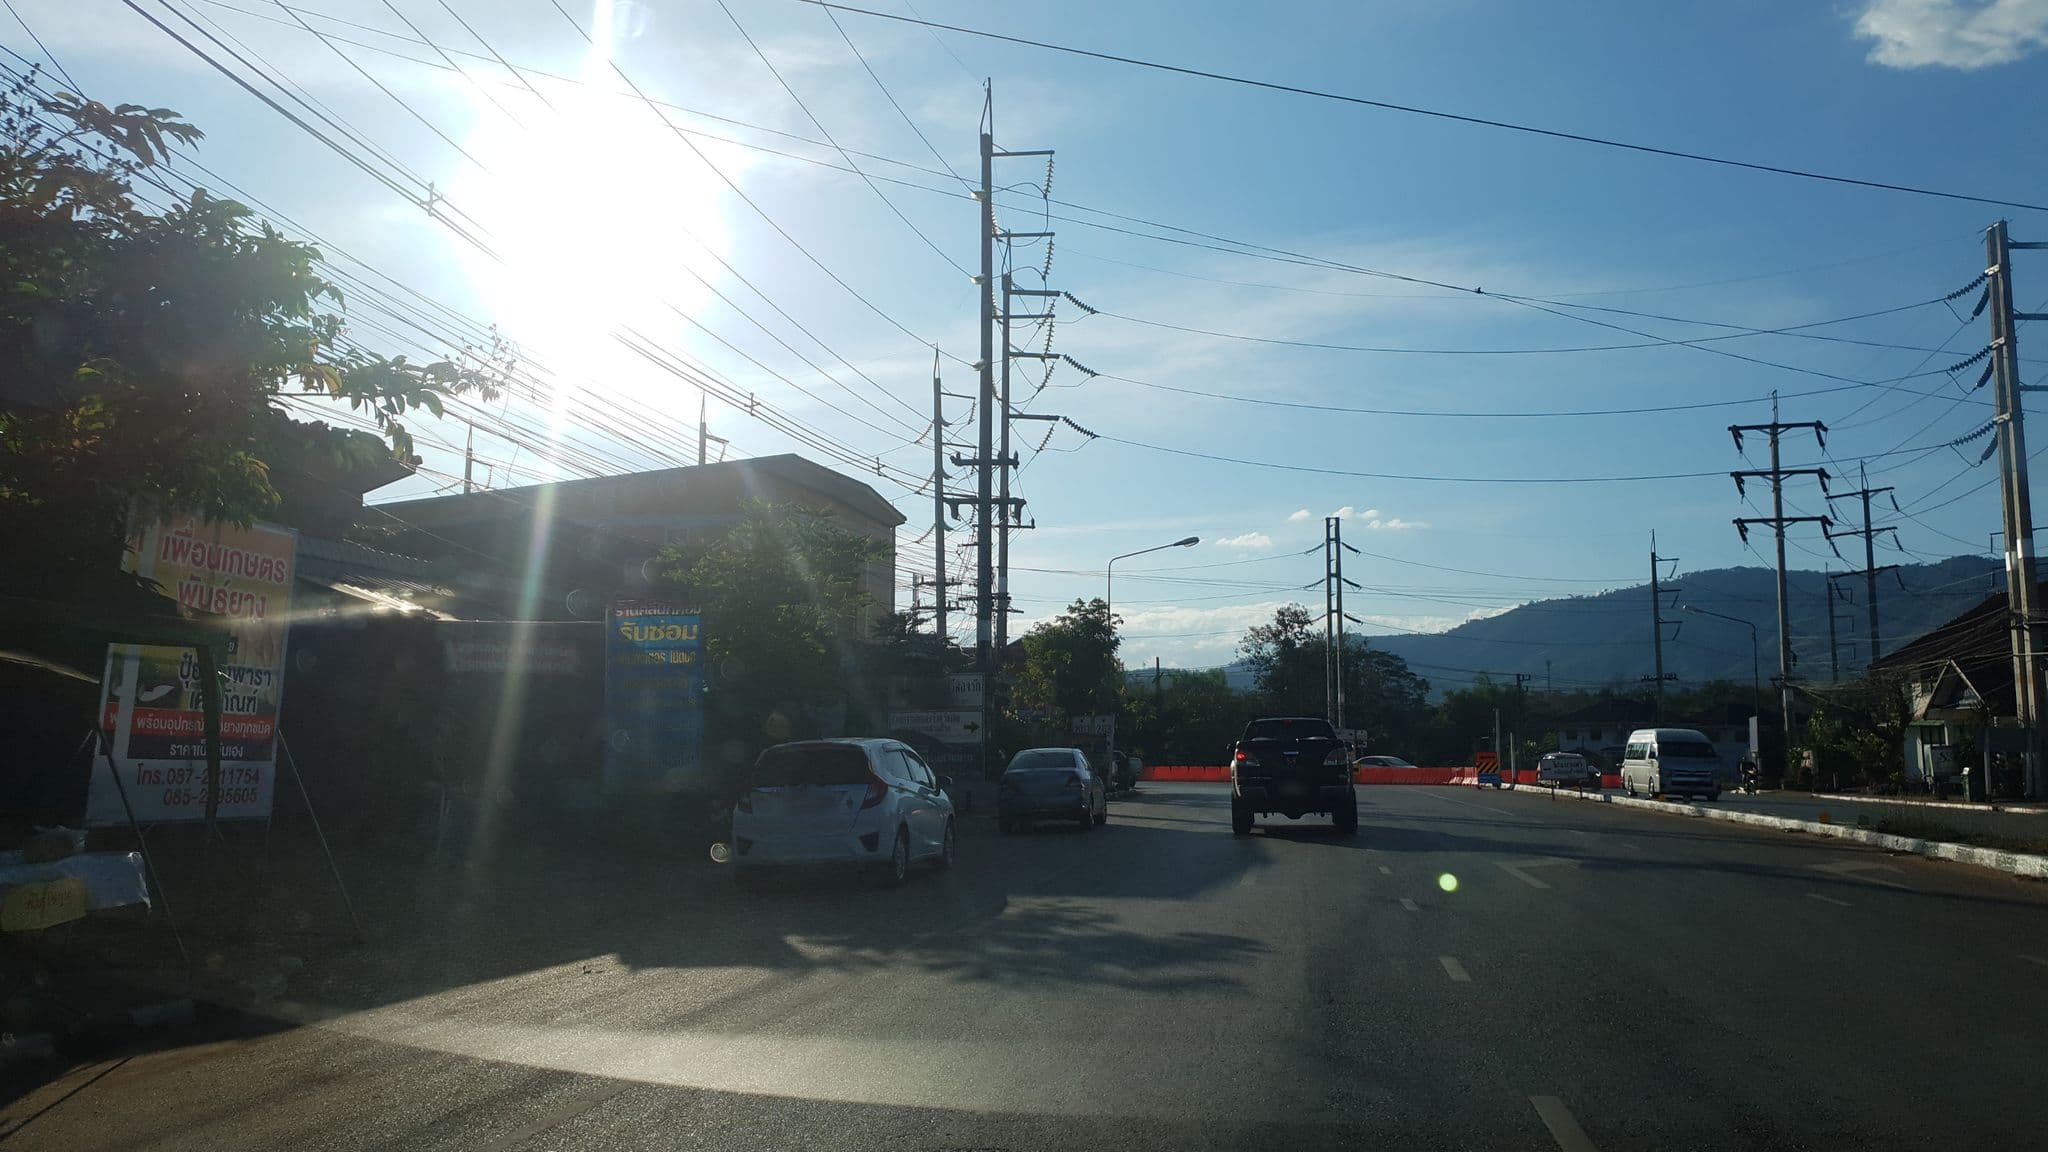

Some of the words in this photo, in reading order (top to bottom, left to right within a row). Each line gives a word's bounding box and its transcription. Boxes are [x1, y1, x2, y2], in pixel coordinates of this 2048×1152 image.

[160, 519, 287, 584] เพื่อนเกษตร
[618, 620, 699, 641] รับซ่อม
[136, 763, 260, 785] โทร.087-211754
